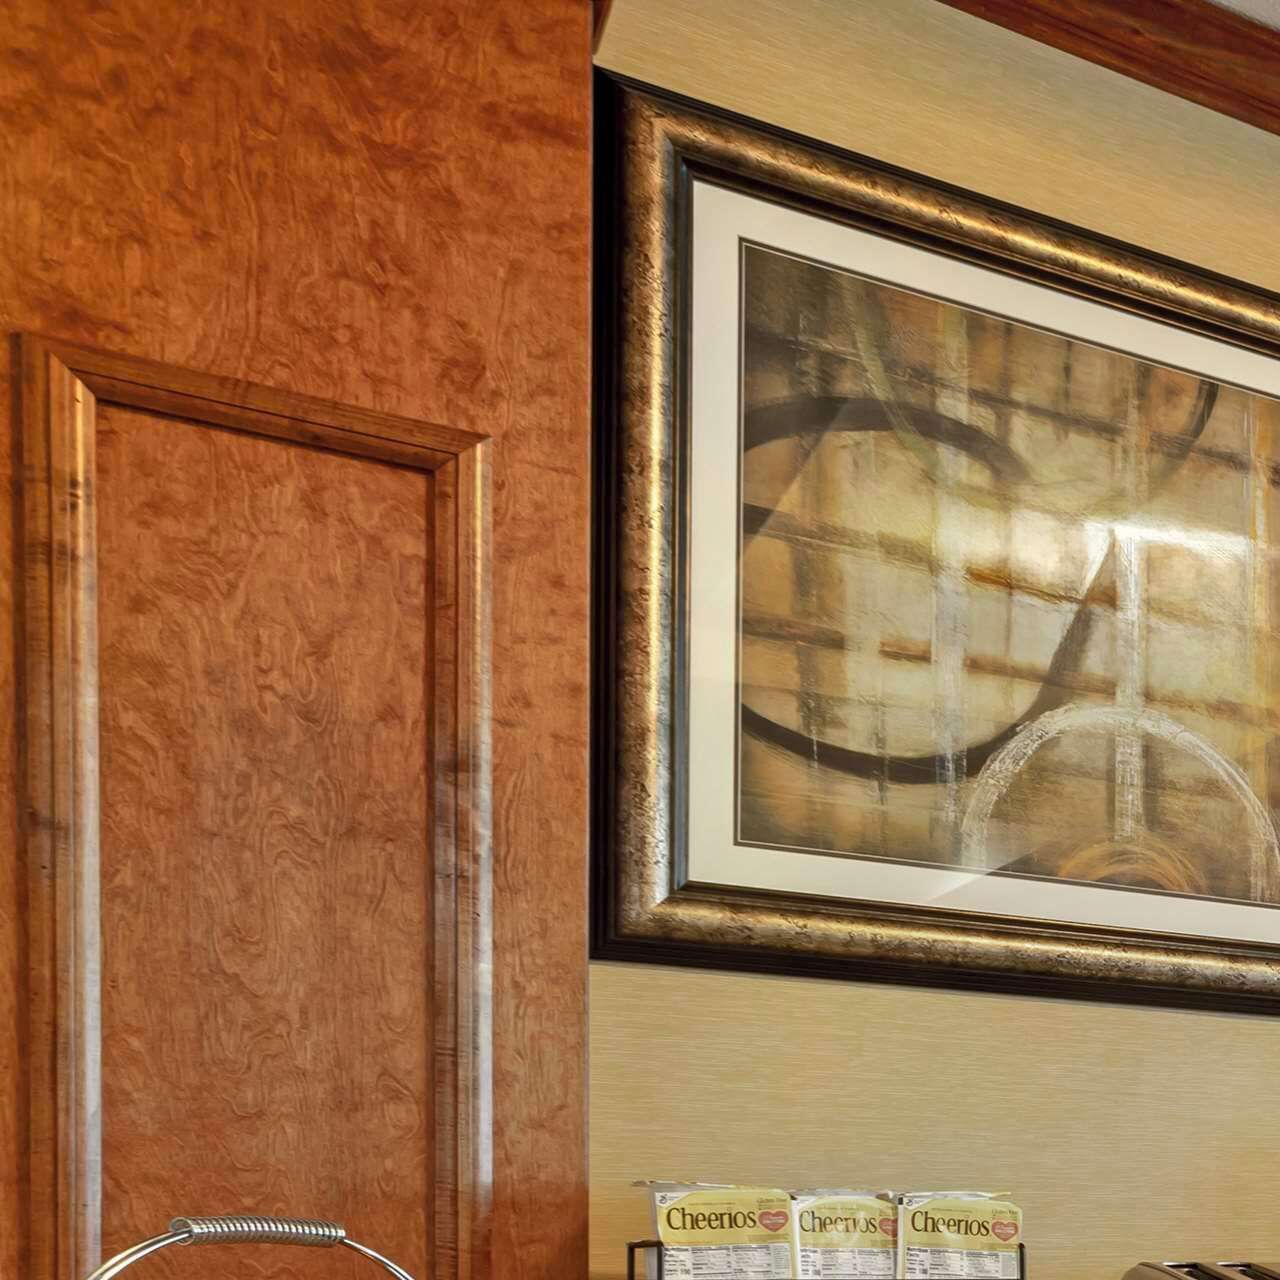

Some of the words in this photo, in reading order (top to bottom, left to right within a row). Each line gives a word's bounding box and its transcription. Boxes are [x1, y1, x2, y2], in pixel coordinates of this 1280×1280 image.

[666, 1207, 757, 1231] Cheerios
[800, 1210, 878, 1234] Cheerios
[911, 1210, 991, 1237] Cheerios
